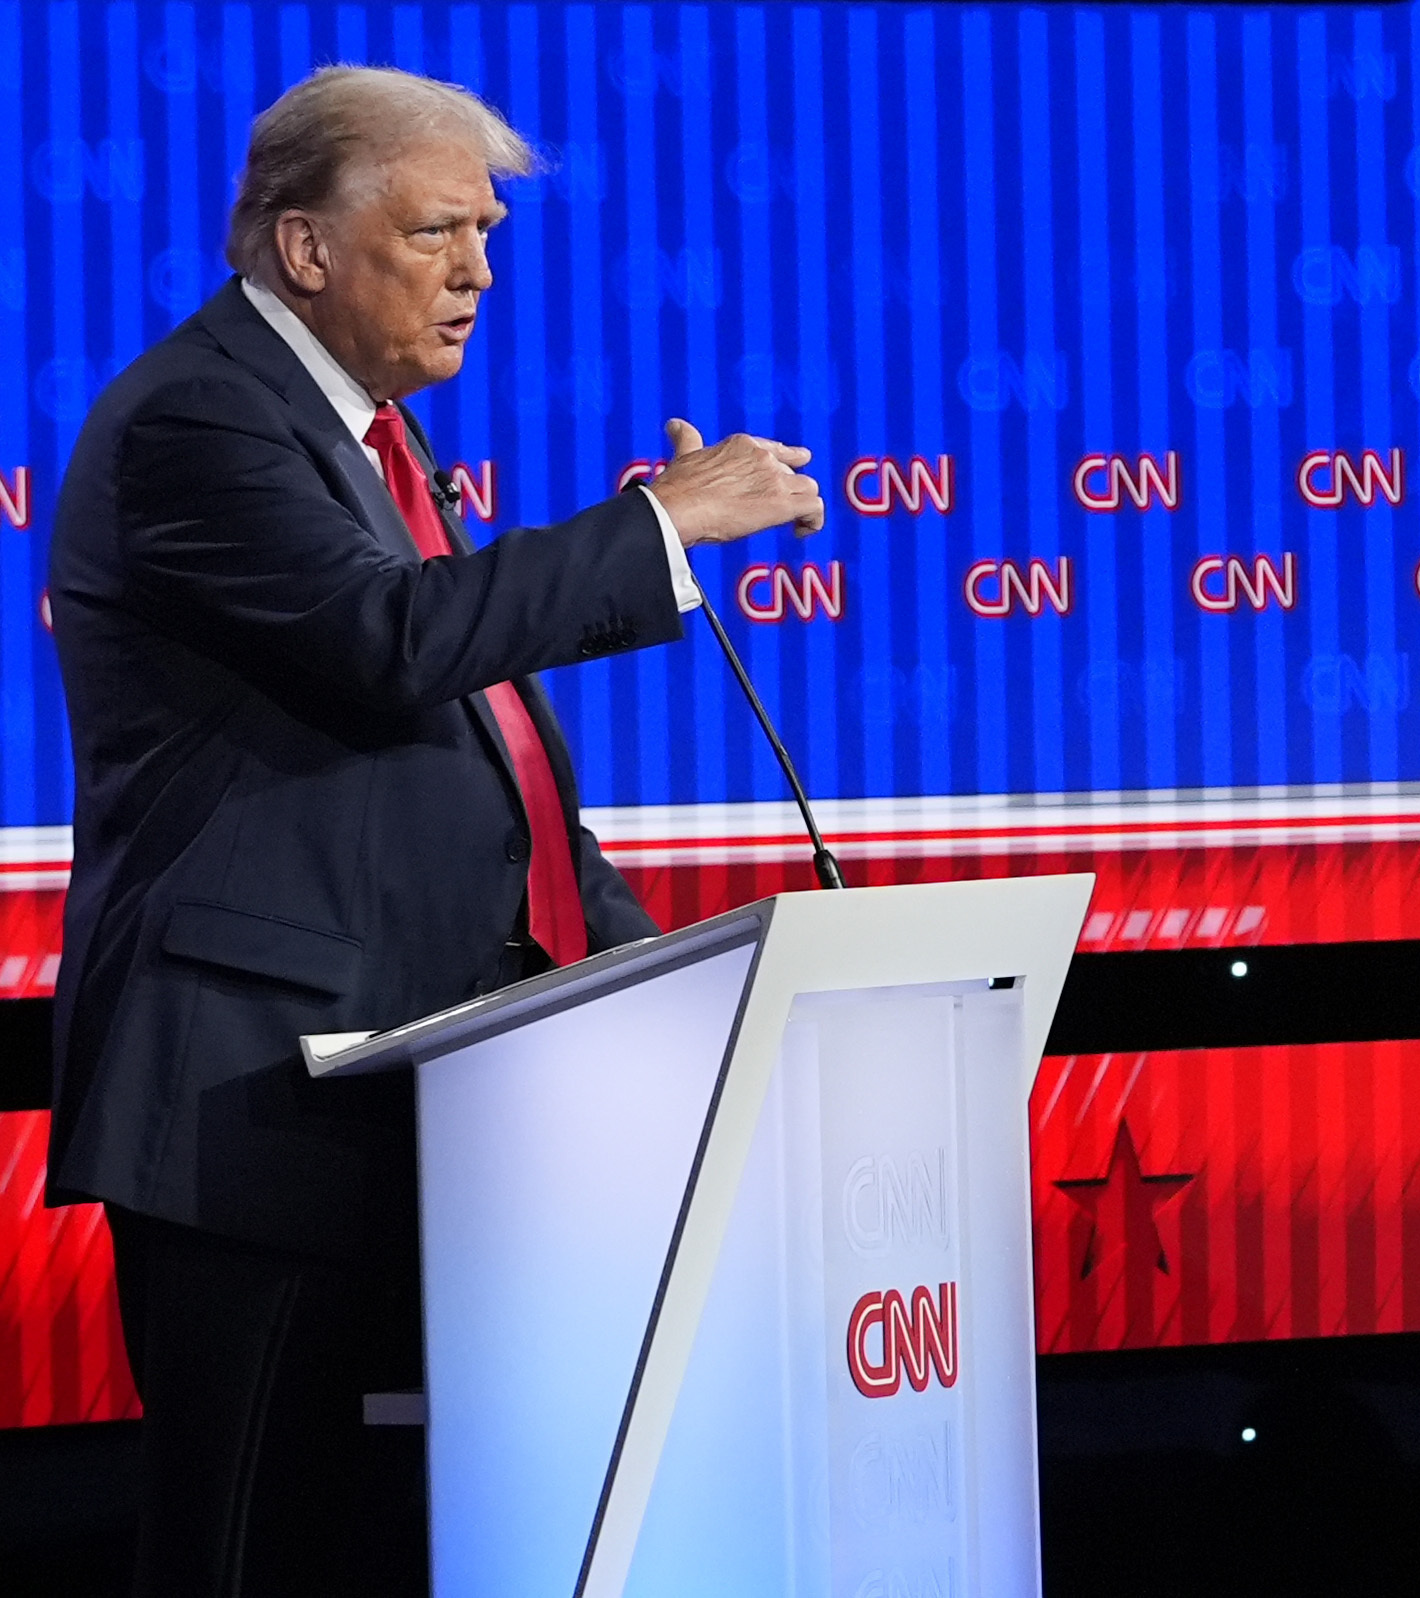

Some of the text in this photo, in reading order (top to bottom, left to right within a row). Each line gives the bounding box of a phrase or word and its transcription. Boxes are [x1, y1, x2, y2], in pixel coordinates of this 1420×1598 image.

[846, 454, 954, 516] CNN
[1073, 450, 1179, 513] CNN
[1298, 447, 1404, 508] CNN
[736, 559, 845, 624] CNN
[963, 555, 1071, 619] CNN
[1190, 551, 1296, 614] CNN
[847, 1281, 958, 1398] CNN
